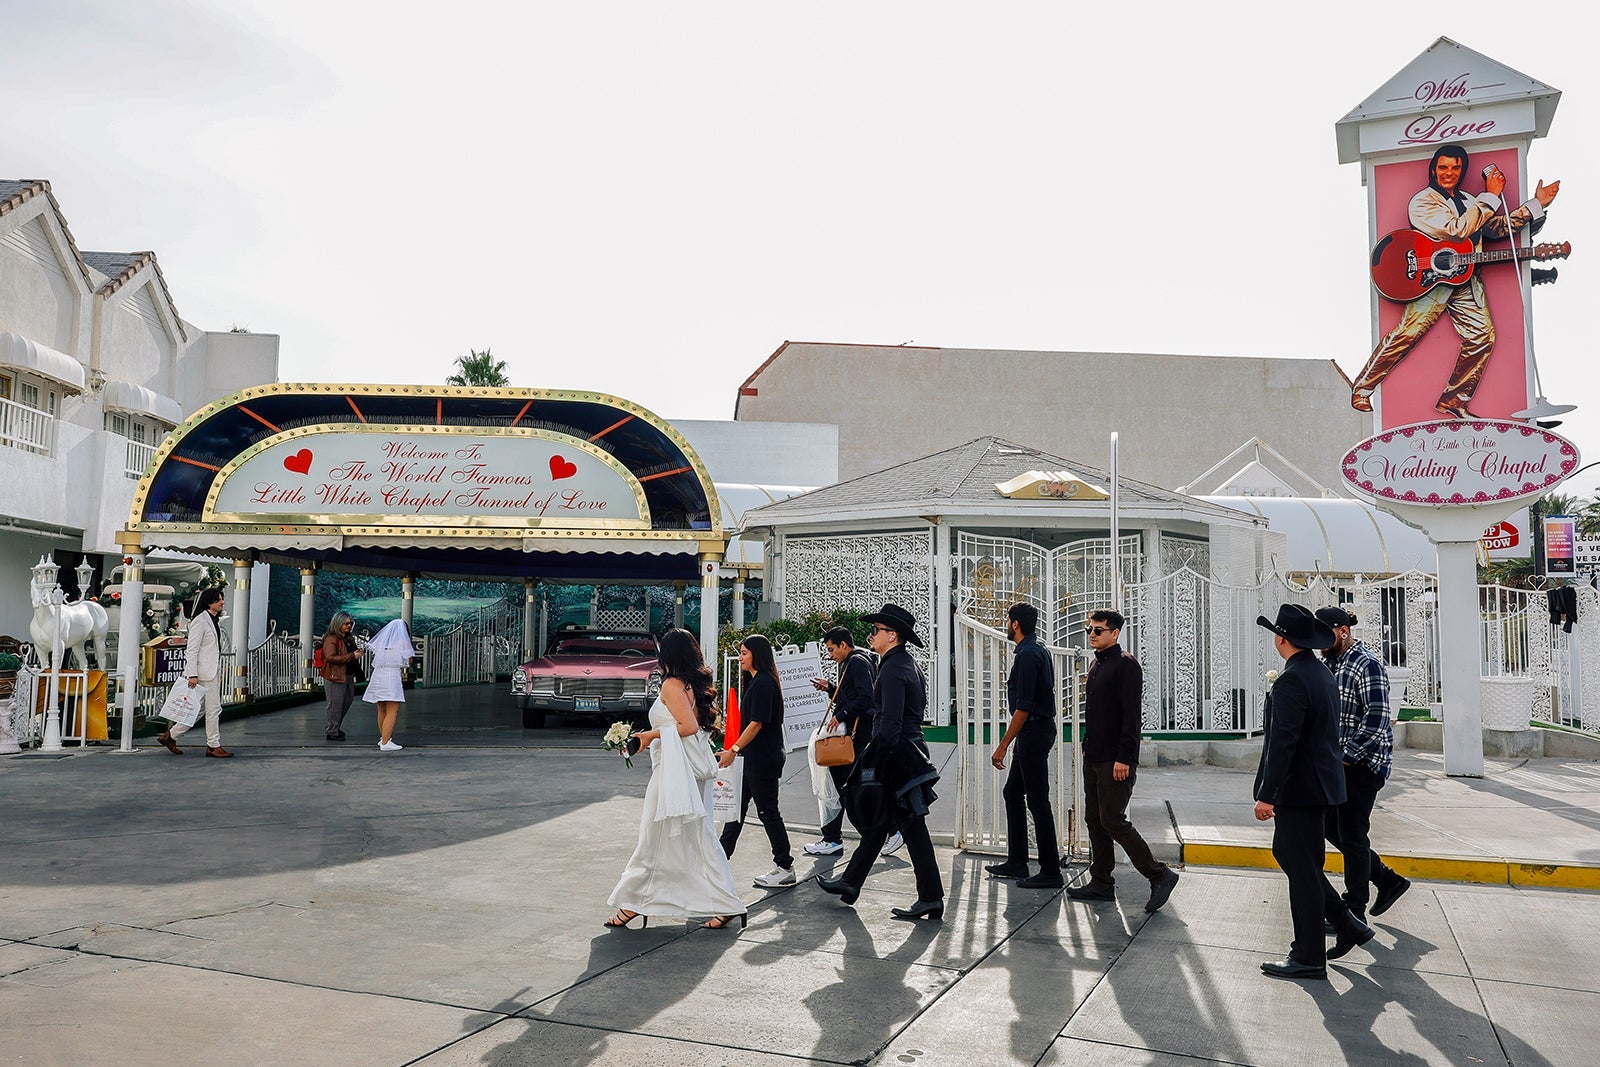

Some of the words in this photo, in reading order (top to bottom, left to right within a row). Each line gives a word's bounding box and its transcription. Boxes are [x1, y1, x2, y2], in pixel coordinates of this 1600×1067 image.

[1414, 72, 1470, 103] With
[1397, 114, 1496, 145] Love
[380, 441, 449, 460] Welcome
[454, 443, 485, 461] To
[1409, 438, 1426, 453] A
[1432, 435, 1460, 452] Little
[1462, 435, 1496, 449] White
[328, 460, 373, 482] The
[380, 461, 447, 483] World
[450, 463, 534, 486] Famous
[1361, 454, 1458, 485] Wedding
[1466, 450, 1548, 482] Chapel
[249, 481, 306, 505] Little
[313, 483, 372, 506] White
[380, 484, 452, 514] Chapel
[454, 487, 535, 510] Tunnel
[534, 490, 558, 517] of
[557, 488, 608, 511] Love
[1484, 538, 1511, 549] DOW
[793, 672, 818, 680] DRIVEWAY
[789, 691, 822, 701] PERMANEZCA
[796, 698, 825, 708] CARRETERA
